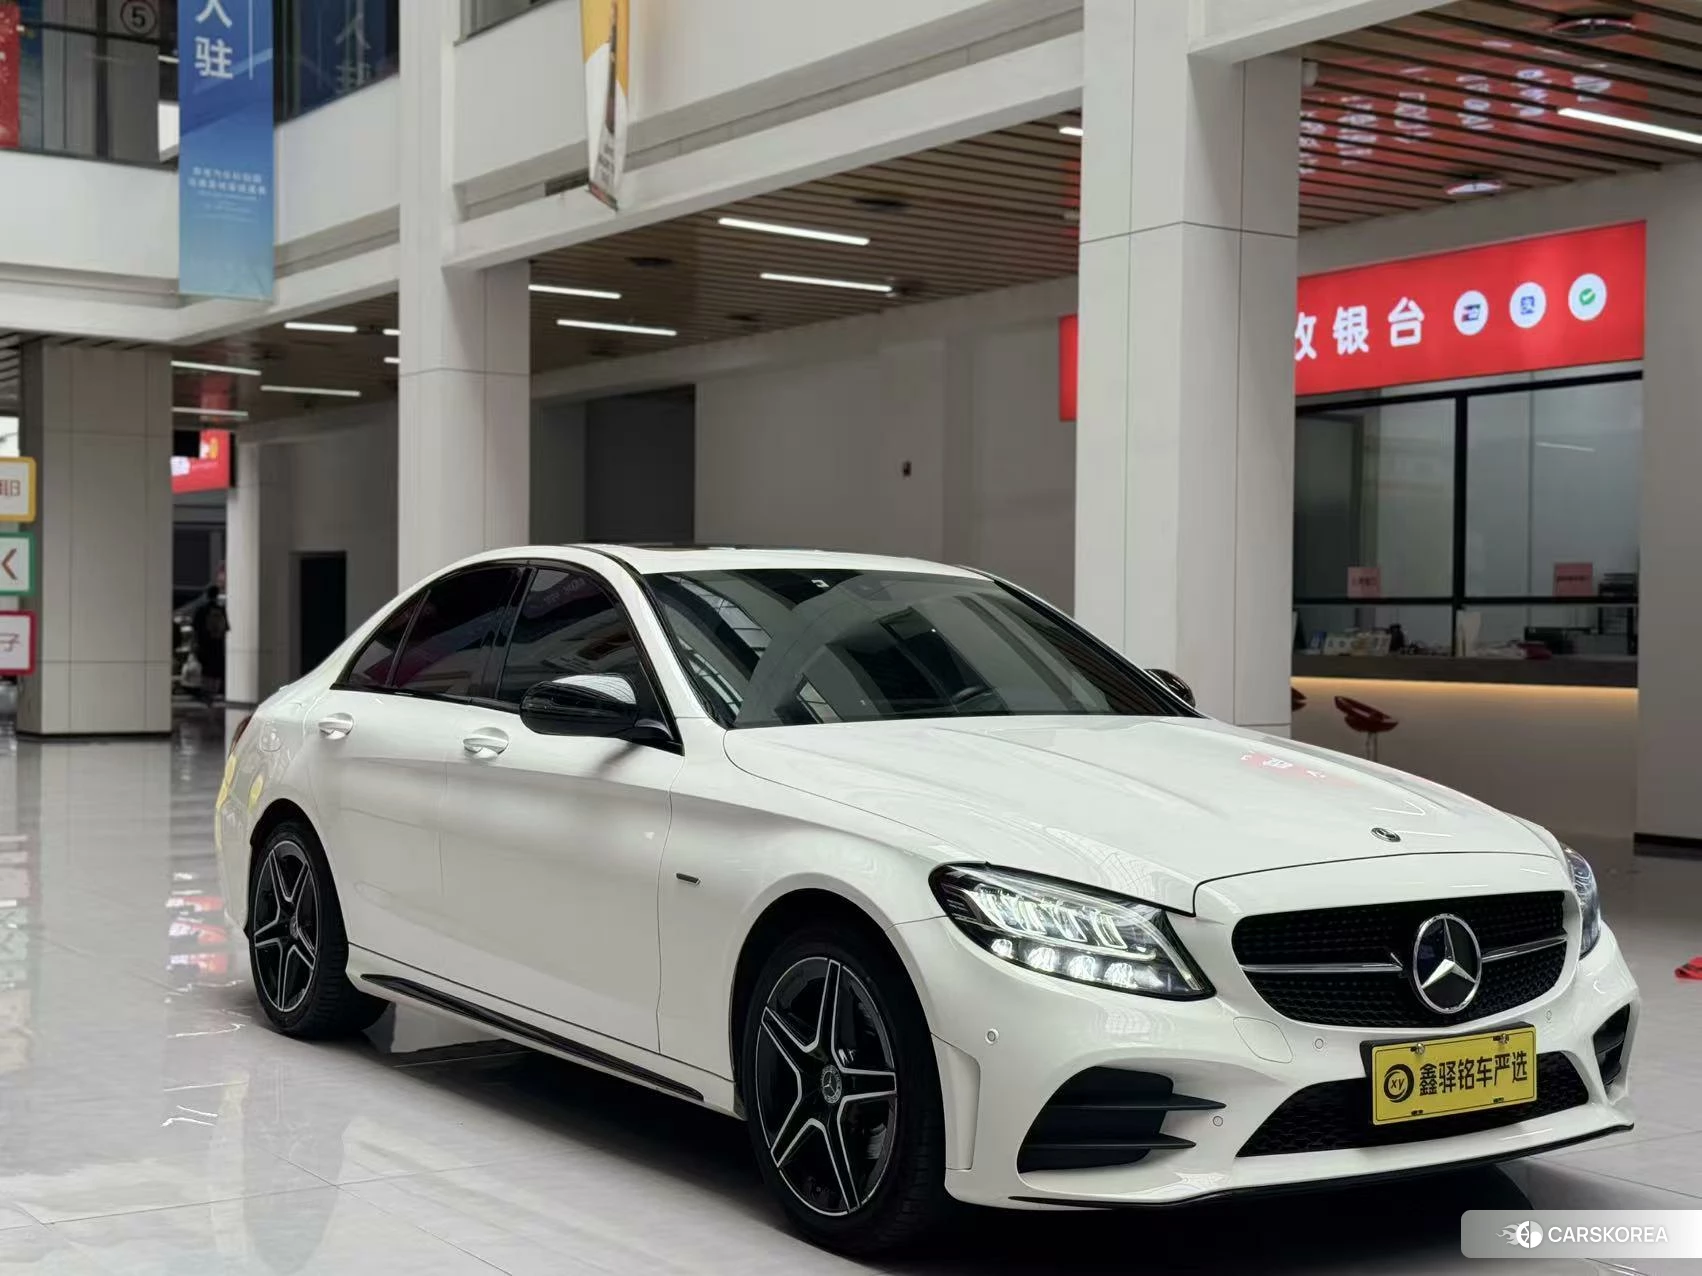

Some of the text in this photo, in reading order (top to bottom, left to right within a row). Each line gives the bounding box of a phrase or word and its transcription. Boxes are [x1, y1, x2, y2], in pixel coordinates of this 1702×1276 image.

[1419, 1050, 1528, 1096] 鑫驿铭车严选
